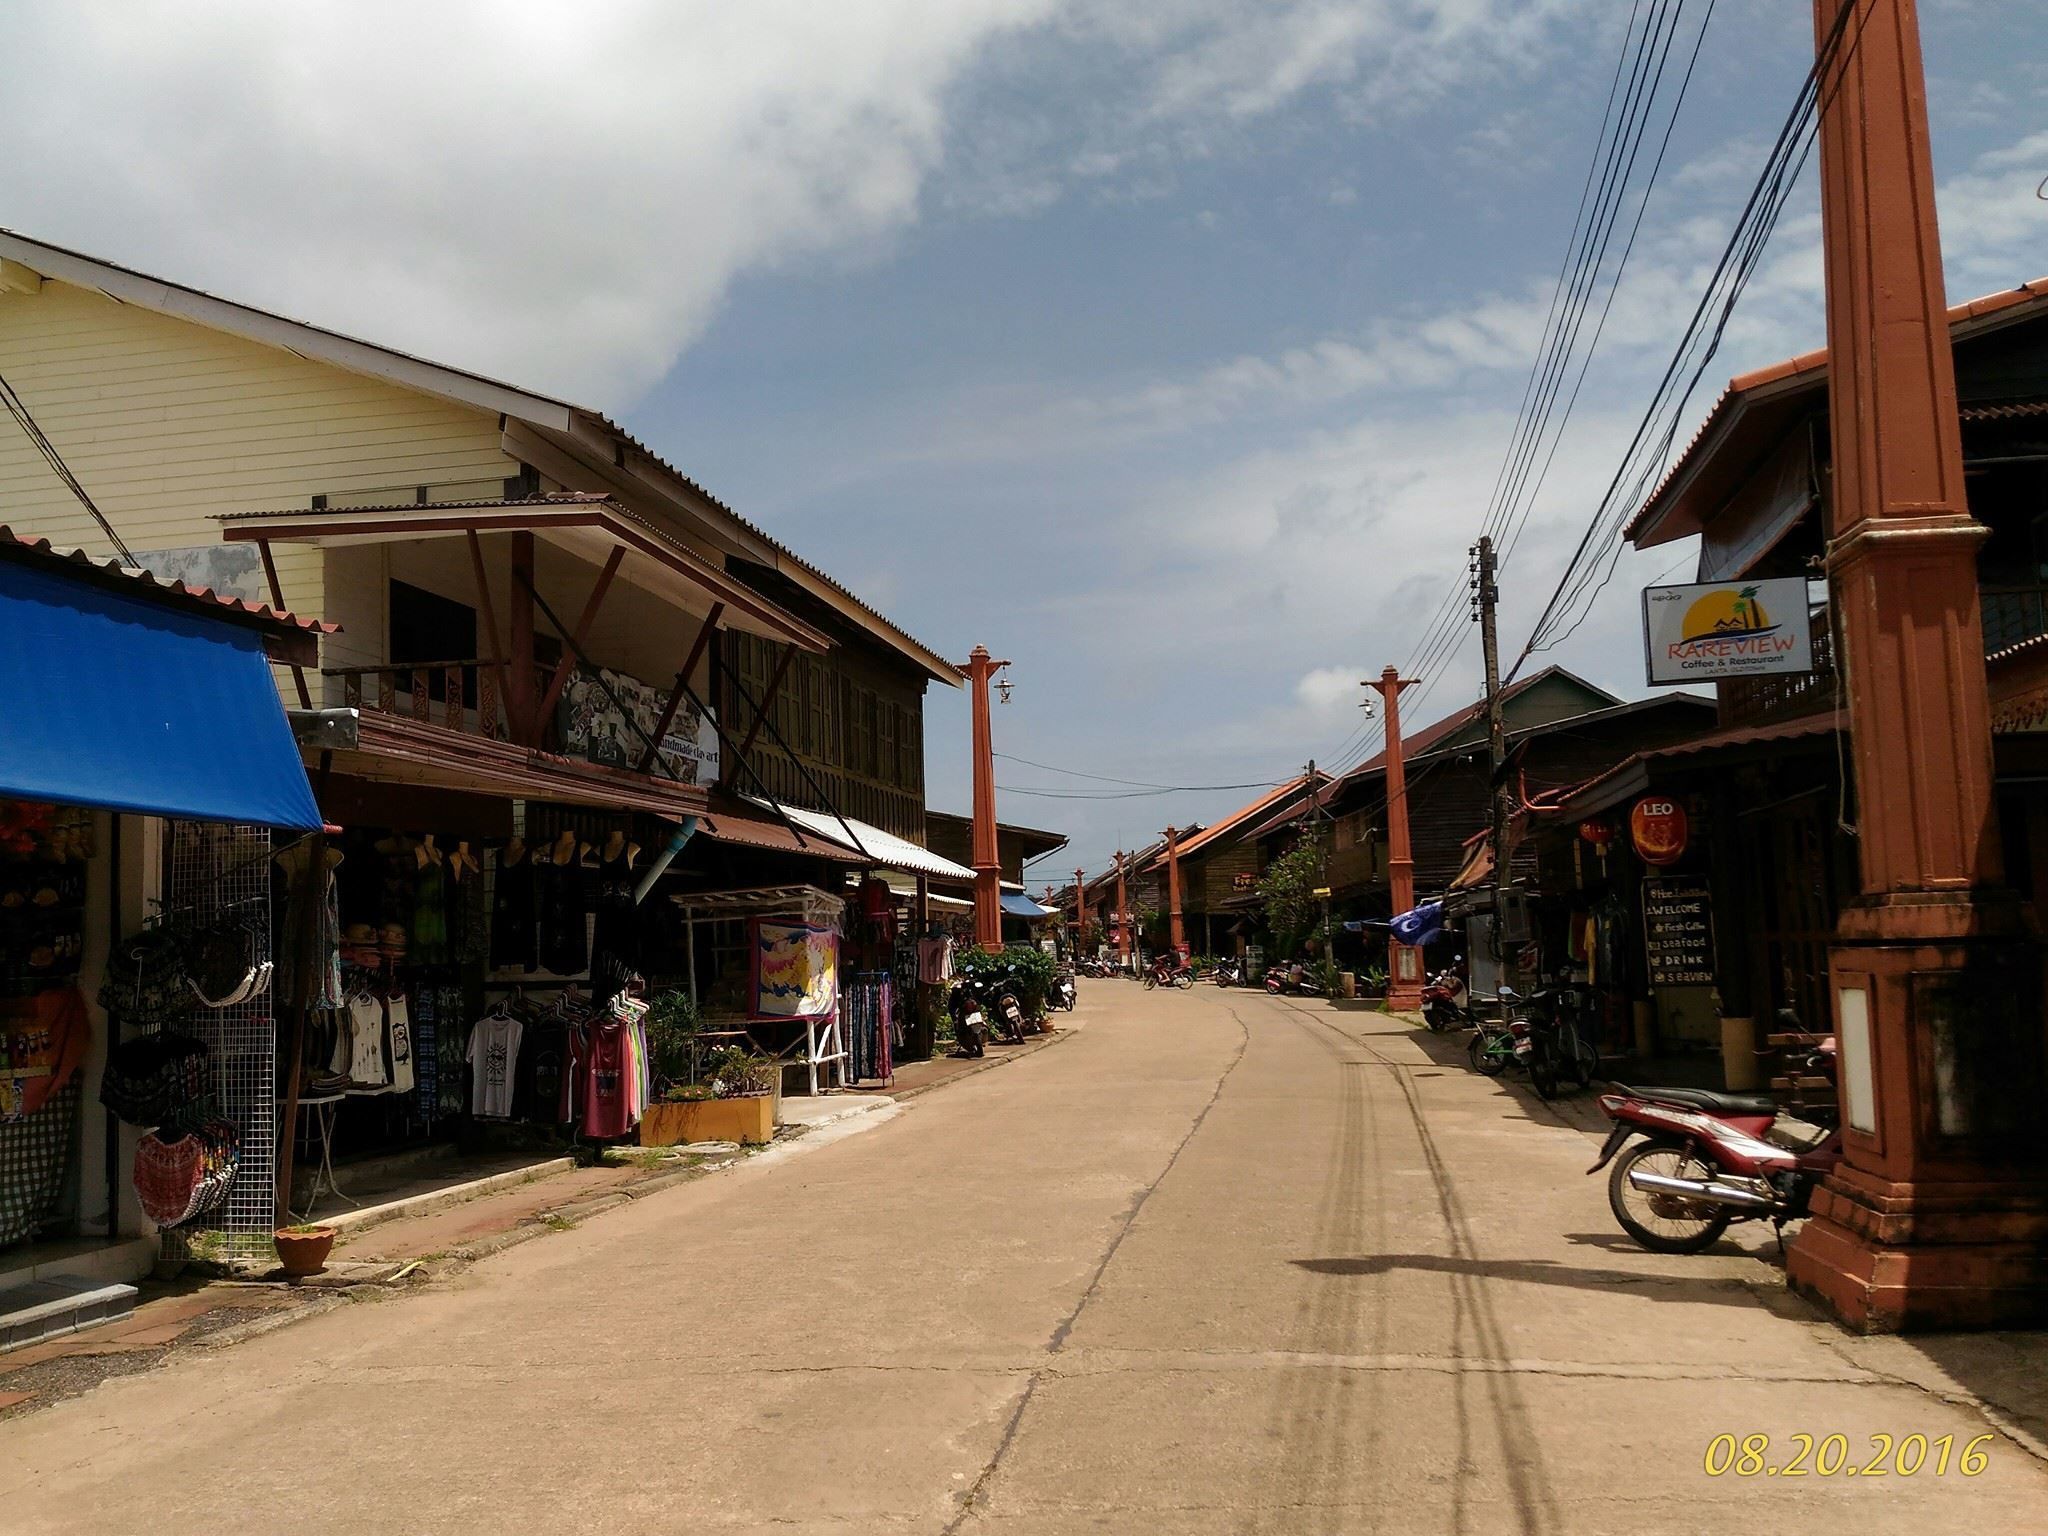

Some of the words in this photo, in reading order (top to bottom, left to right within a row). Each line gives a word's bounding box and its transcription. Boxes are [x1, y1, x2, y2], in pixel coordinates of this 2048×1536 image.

[1667, 634, 1796, 659] RAREVIEW
[1681, 659, 1715, 669] Coffee
[1718, 658, 1726, 667] &
[1729, 655, 1785, 666] Restaurant
[660, 738, 693, 756] andmade
[706, 751, 719, 763] art
[1643, 803, 1674, 816] LEO
[1652, 903, 1701, 915] WELCOME
[1665, 954, 1704, 966] DRINK
